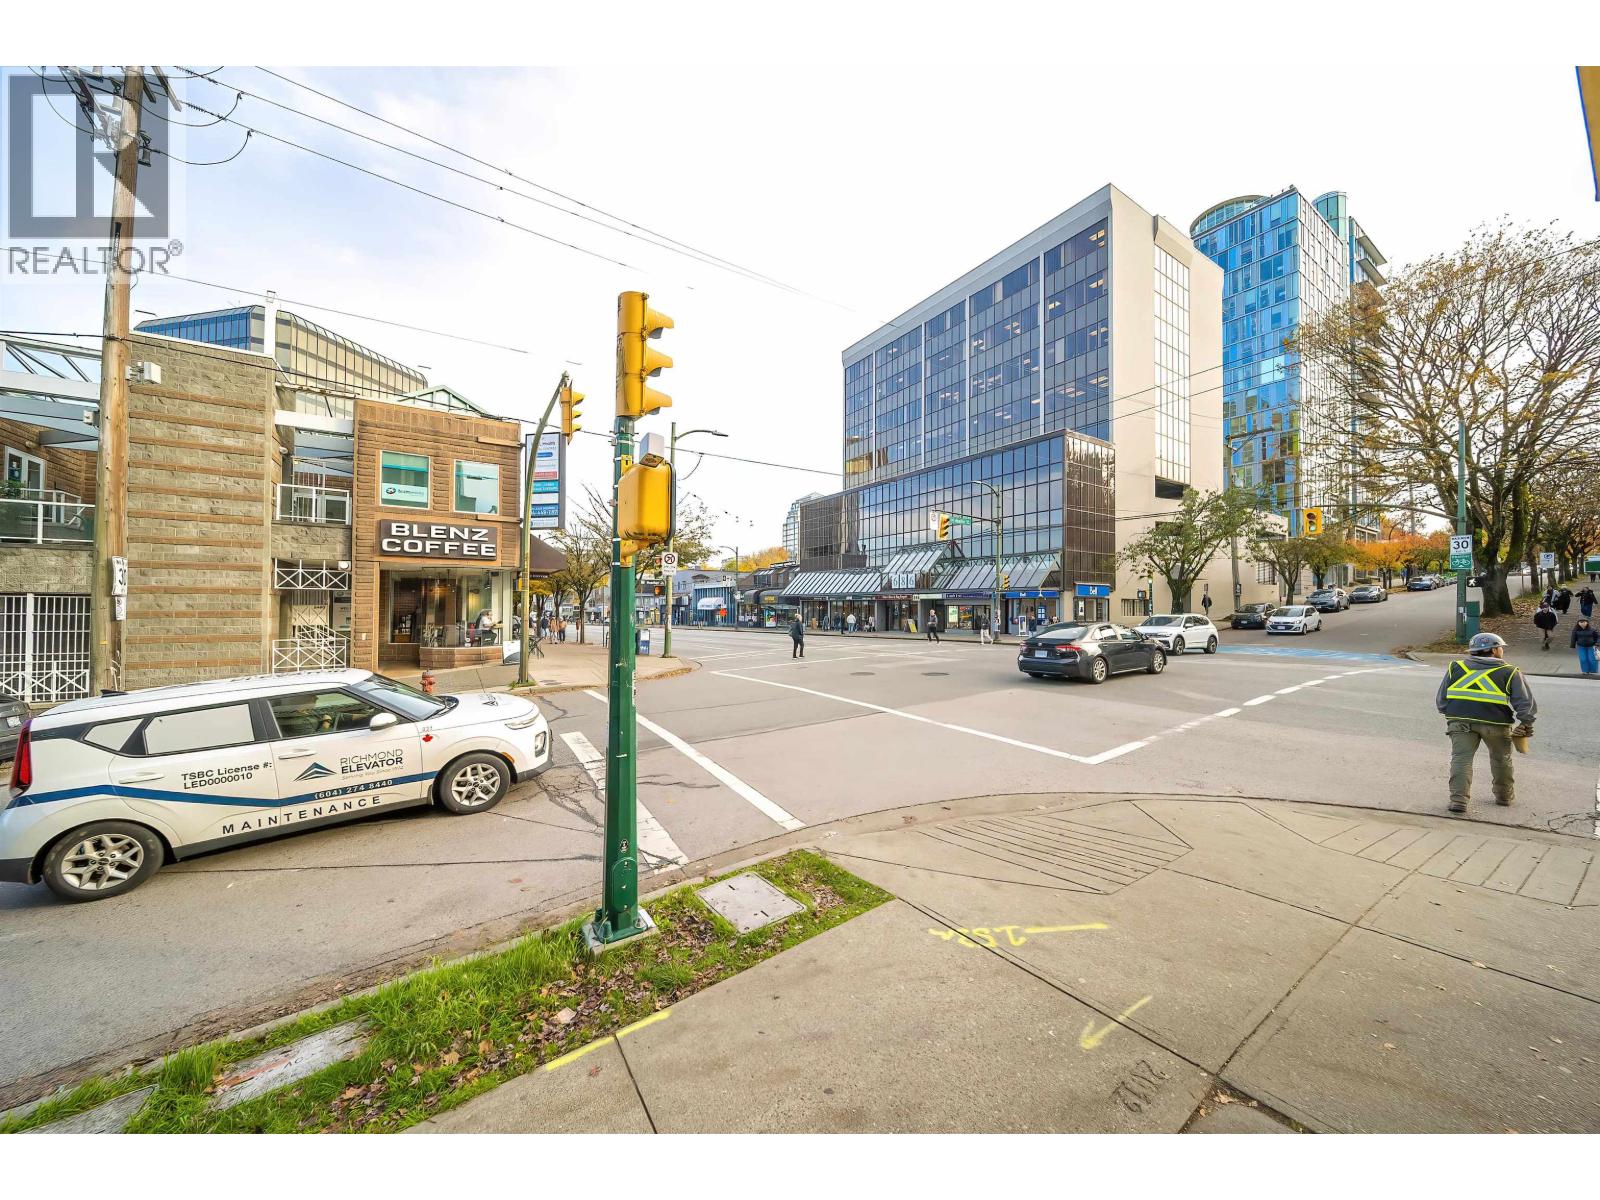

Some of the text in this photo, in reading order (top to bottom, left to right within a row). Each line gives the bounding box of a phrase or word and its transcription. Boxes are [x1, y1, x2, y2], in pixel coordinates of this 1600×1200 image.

[391, 522, 489, 541] BLENZ
[382, 537, 497, 557] COFFEE
[1453, 541, 1469, 549] 30
[893, 576, 914, 588] 686
[1089, 586, 1098, 595] Bell
[340, 748, 404, 766] RICHMOND
[341, 756, 403, 774] ELEVATOR
[181, 769, 214, 781] TSBC
[217, 761, 260, 777] License
[183, 772, 253, 790] LED0000010
[314, 779, 394, 800] (604) 274 8440
[222, 795, 382, 835] MAINTENANCE
